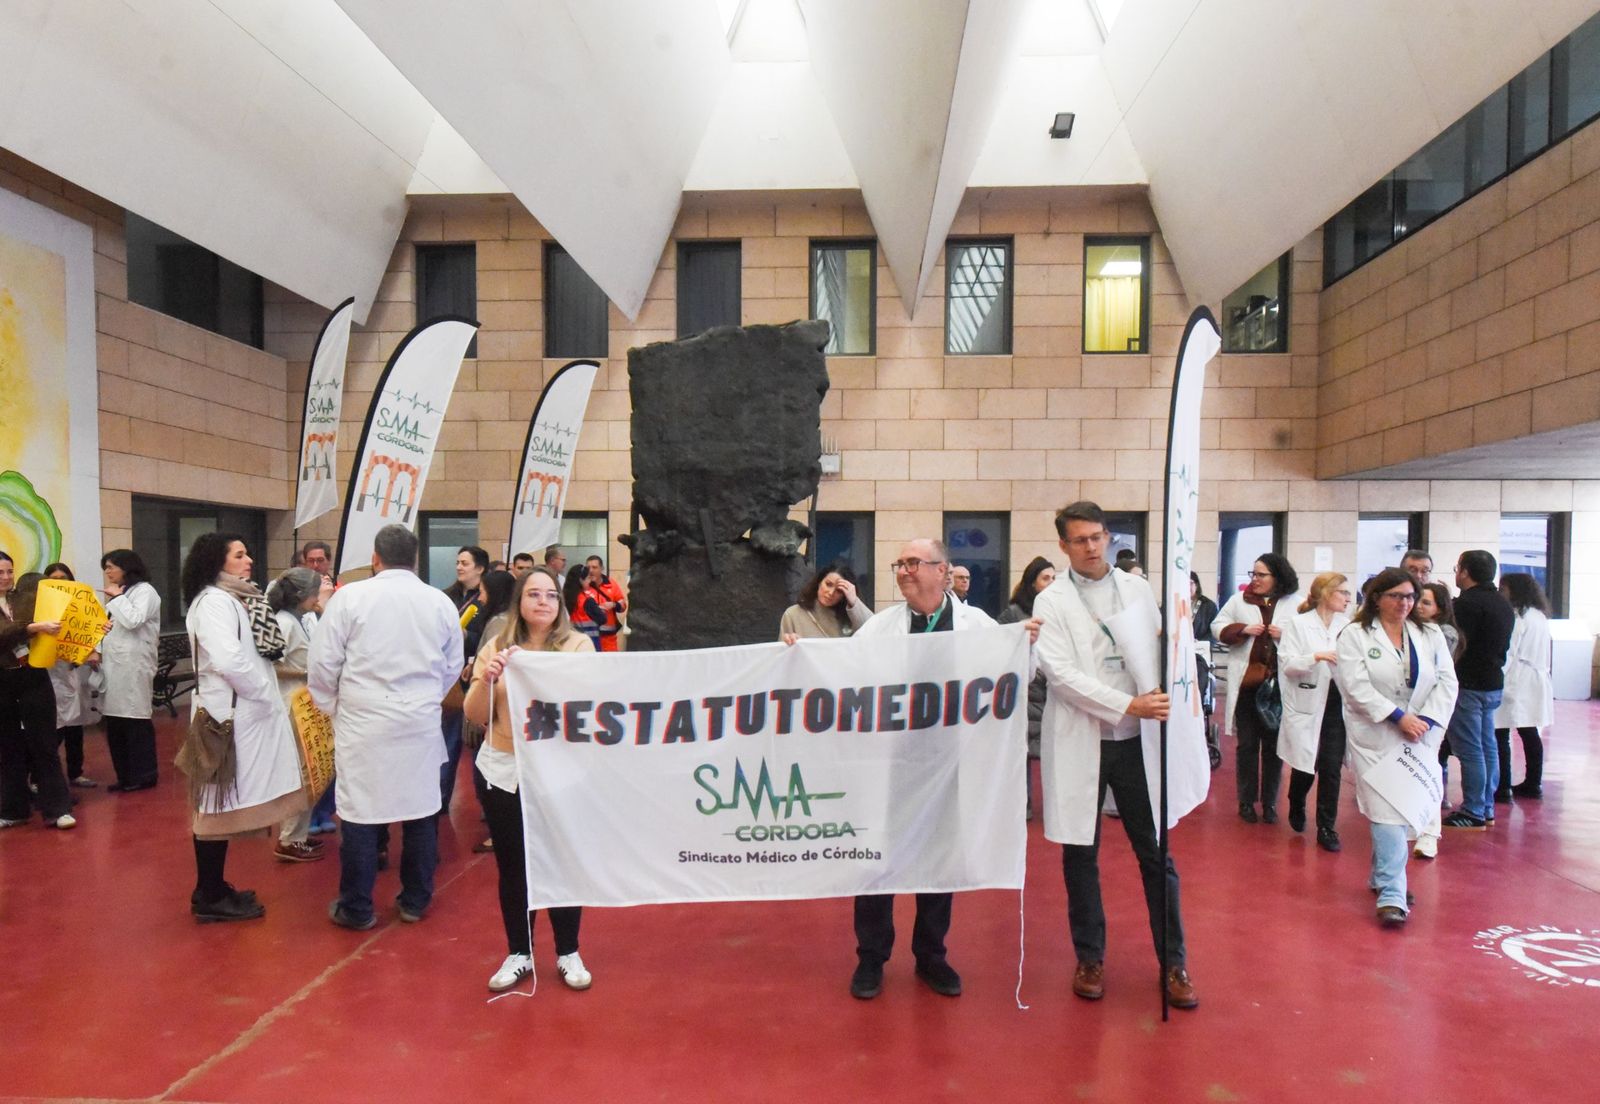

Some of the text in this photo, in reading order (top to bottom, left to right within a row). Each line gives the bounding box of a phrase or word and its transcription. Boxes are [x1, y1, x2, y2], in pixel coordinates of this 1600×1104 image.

[377, 407, 431, 441] SMA
[377, 432, 424, 455] CÓRDOBA
[531, 436, 568, 459] SMA
[531, 454, 567, 467] CÓRDOBA
[84, 606, 99, 618] UN
[63, 629, 96, 645] AGOTA
[523, 671, 1020, 746] #ESTATUTOMEDICO
[1396, 757, 1415, 774] para
[694, 757, 846, 821] SMA
[678, 845, 882, 864] Sindicato Médico de Córdoba
